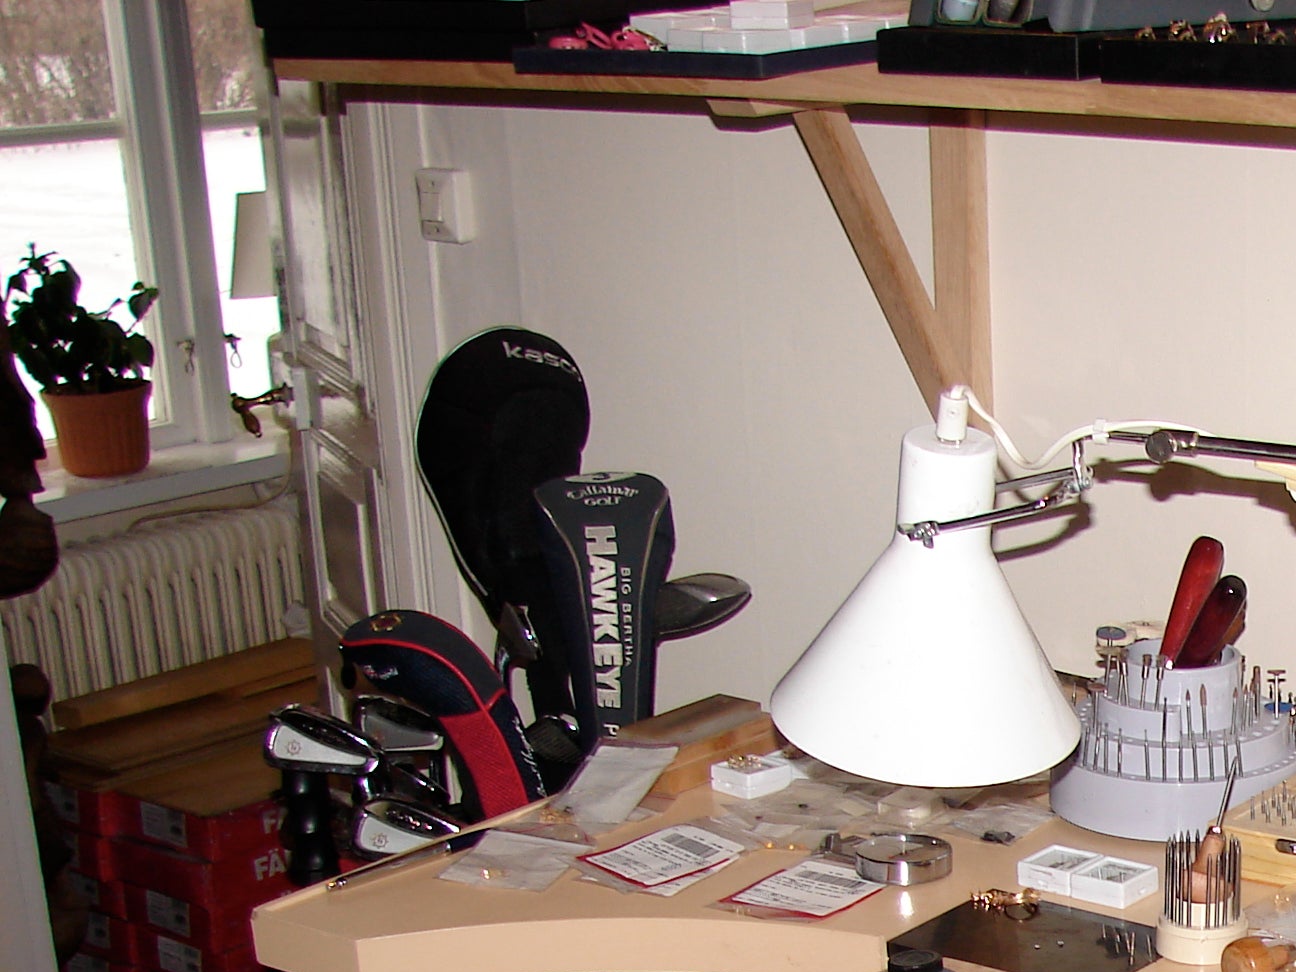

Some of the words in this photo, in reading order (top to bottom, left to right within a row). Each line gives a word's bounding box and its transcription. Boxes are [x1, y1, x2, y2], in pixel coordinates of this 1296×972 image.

[502, 341, 582, 382] kasc
[620, 567, 632, 595] BIG
[584, 525, 624, 709] HAWKEYE
[622, 603, 634, 668] BERTHA
